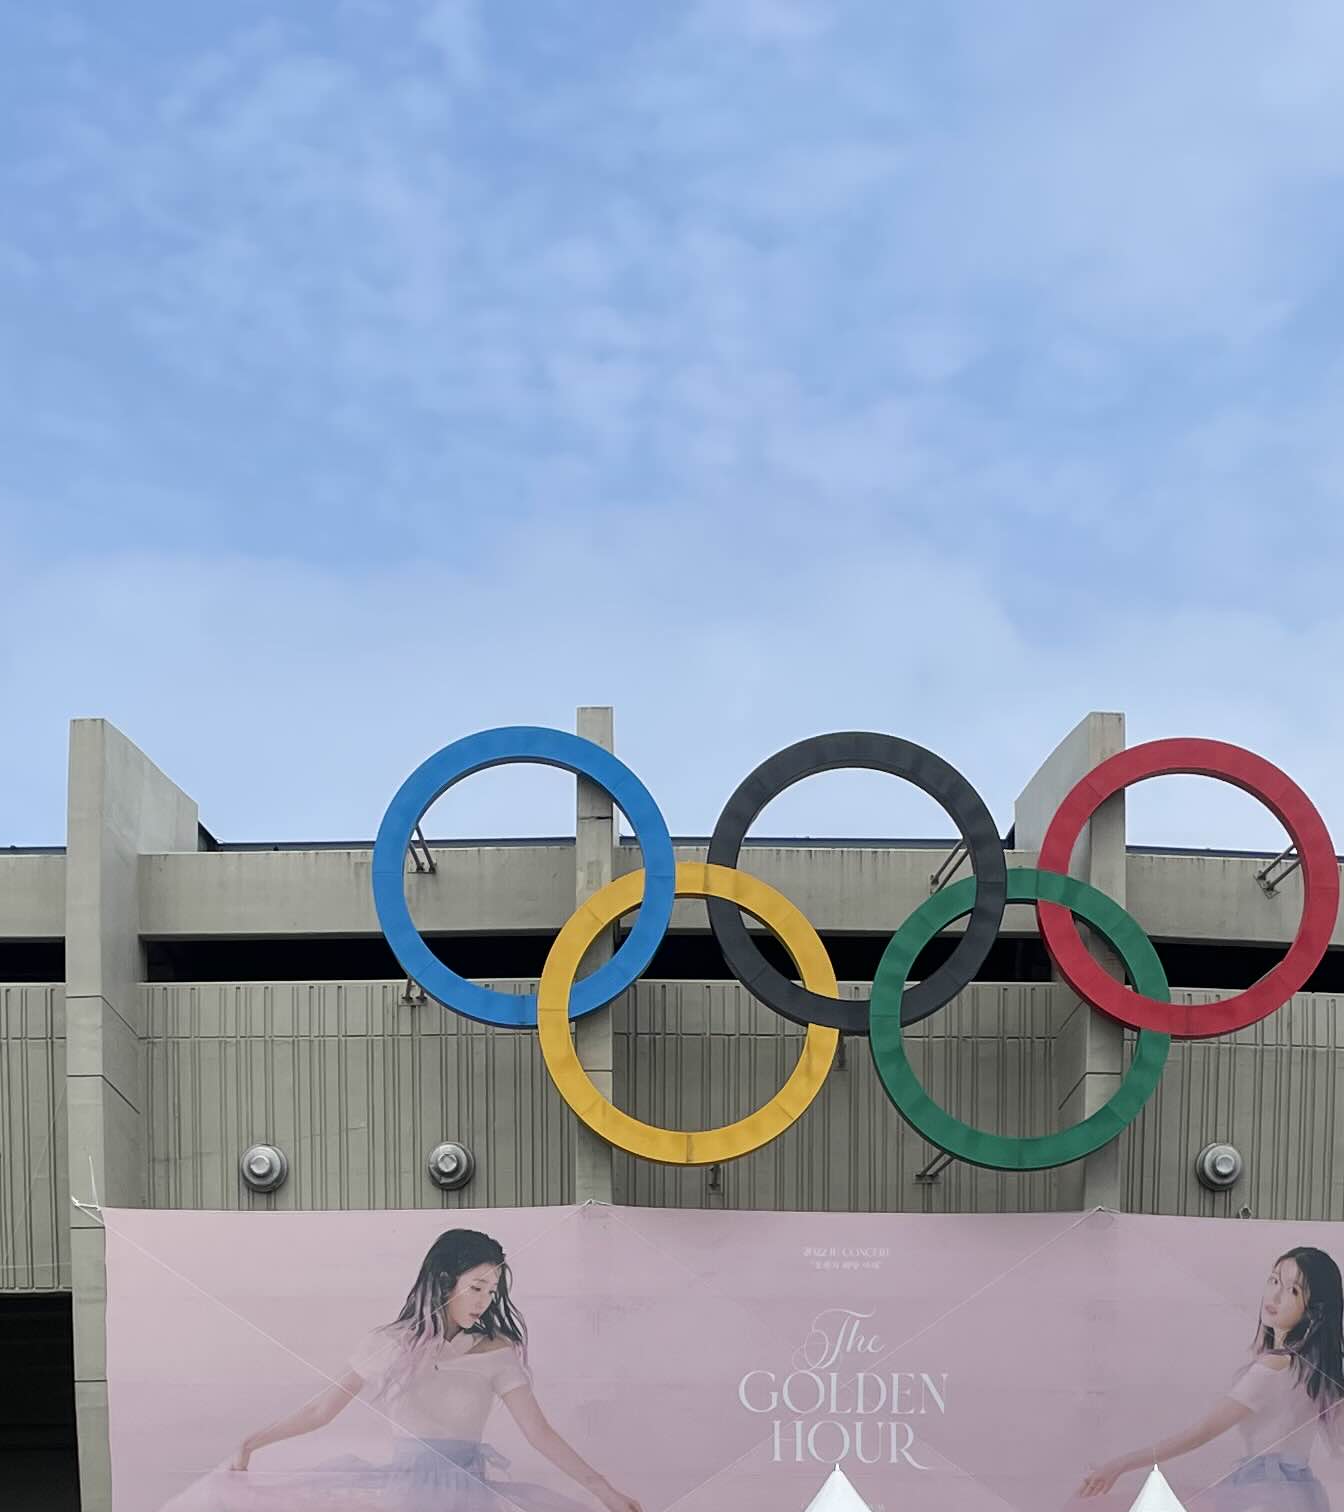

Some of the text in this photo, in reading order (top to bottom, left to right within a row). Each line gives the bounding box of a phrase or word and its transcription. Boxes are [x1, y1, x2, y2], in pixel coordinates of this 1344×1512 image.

[792, 1307, 887, 1372] The
[738, 1369, 949, 1415] GOLDEN
[771, 1420, 931, 1470] HOUR
